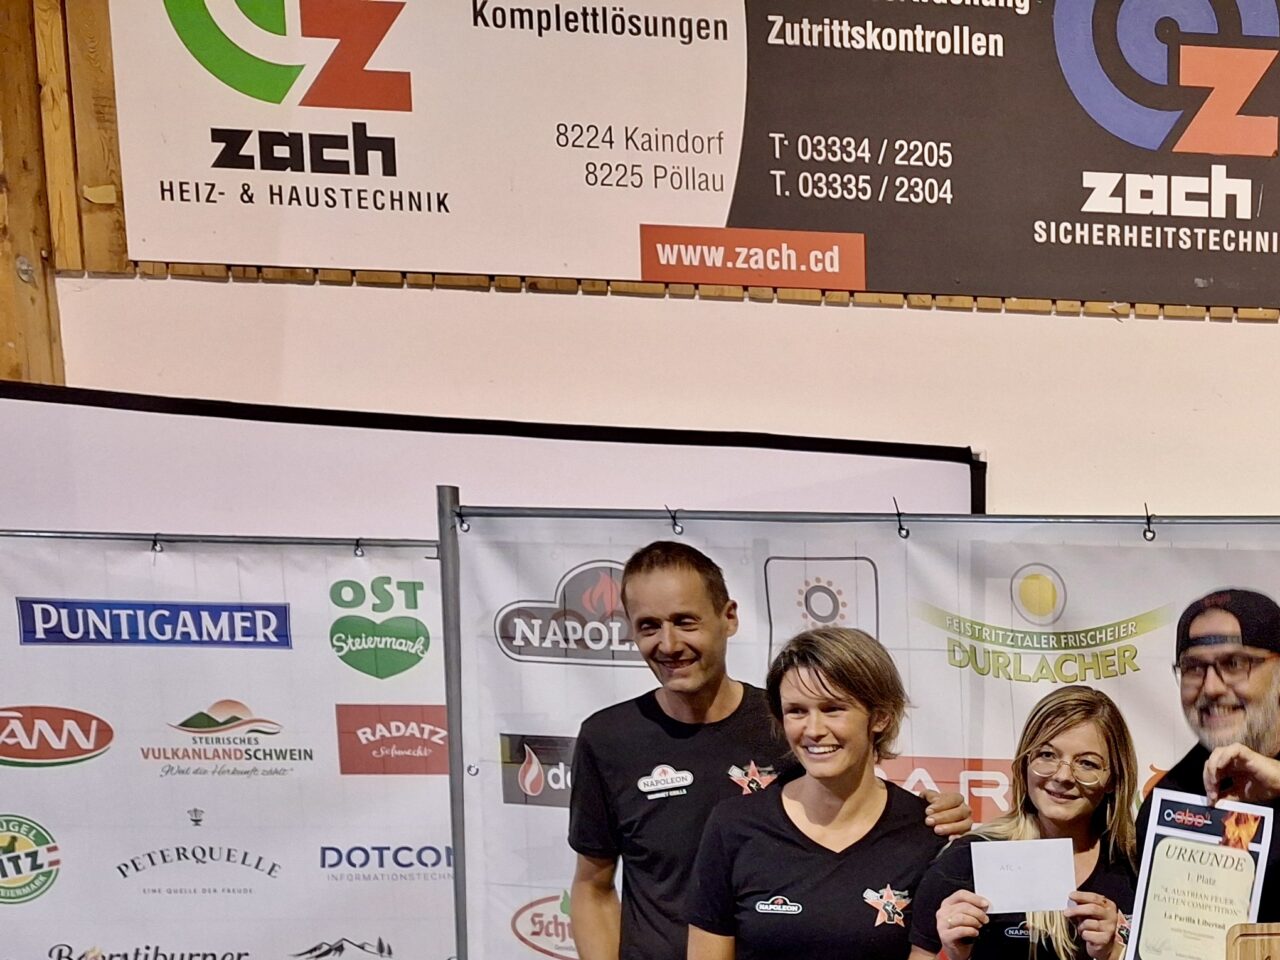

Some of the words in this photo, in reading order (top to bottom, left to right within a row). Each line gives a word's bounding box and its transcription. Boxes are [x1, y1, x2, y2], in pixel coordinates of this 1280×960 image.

[472, 0, 729, 45] Komplettlösungen
[767, 15, 1004, 57] Zutrittskontrollen
[210, 122, 398, 177] zach
[555, 123, 615, 151] 8224
[623, 126, 725, 156] Kaindorf
[797, 134, 872, 165] 03334
[877, 138, 889, 166] /
[894, 140, 953, 169] 2205
[584, 163, 644, 189] 8225
[652, 164, 725, 193] Pöllau
[770, 170, 791, 197] T.
[798, 172, 872, 201] 03335
[878, 175, 889, 202] /
[895, 177, 954, 205] 2304
[1081, 164, 1252, 220] zach
[160, 180, 226, 204] HEIZ-
[239, 184, 255, 205] &
[268, 184, 451, 213] HAUSTECHNIK
[656, 240, 840, 273] www.zach.cd
[329, 575, 425, 613] OST
[31, 602, 279, 643] PUNTIGAMER
[945, 616, 1058, 649] FEISTRITZTALER
[1060, 621, 1138, 648] FRISCHEIER
[331, 623, 428, 657] Steiermark
[947, 636, 1141, 684] DURLACHER
[192, 736, 260, 746] STEIRISCHES
[356, 720, 448, 745] RADATZ
[140, 747, 314, 761] VULKANLANDSCHWEIN
[642, 775, 689, 789] NAPOLEON
[116, 845, 282, 879] PETERQUELLE
[1165, 844, 1248, 873] URKUNDE
[1172, 886, 1209, 900] AUSTRIAN
[1196, 873, 1217, 886] Platz
[1153, 893, 1186, 907] PLATTEN
[1163, 911, 1173, 920] La
